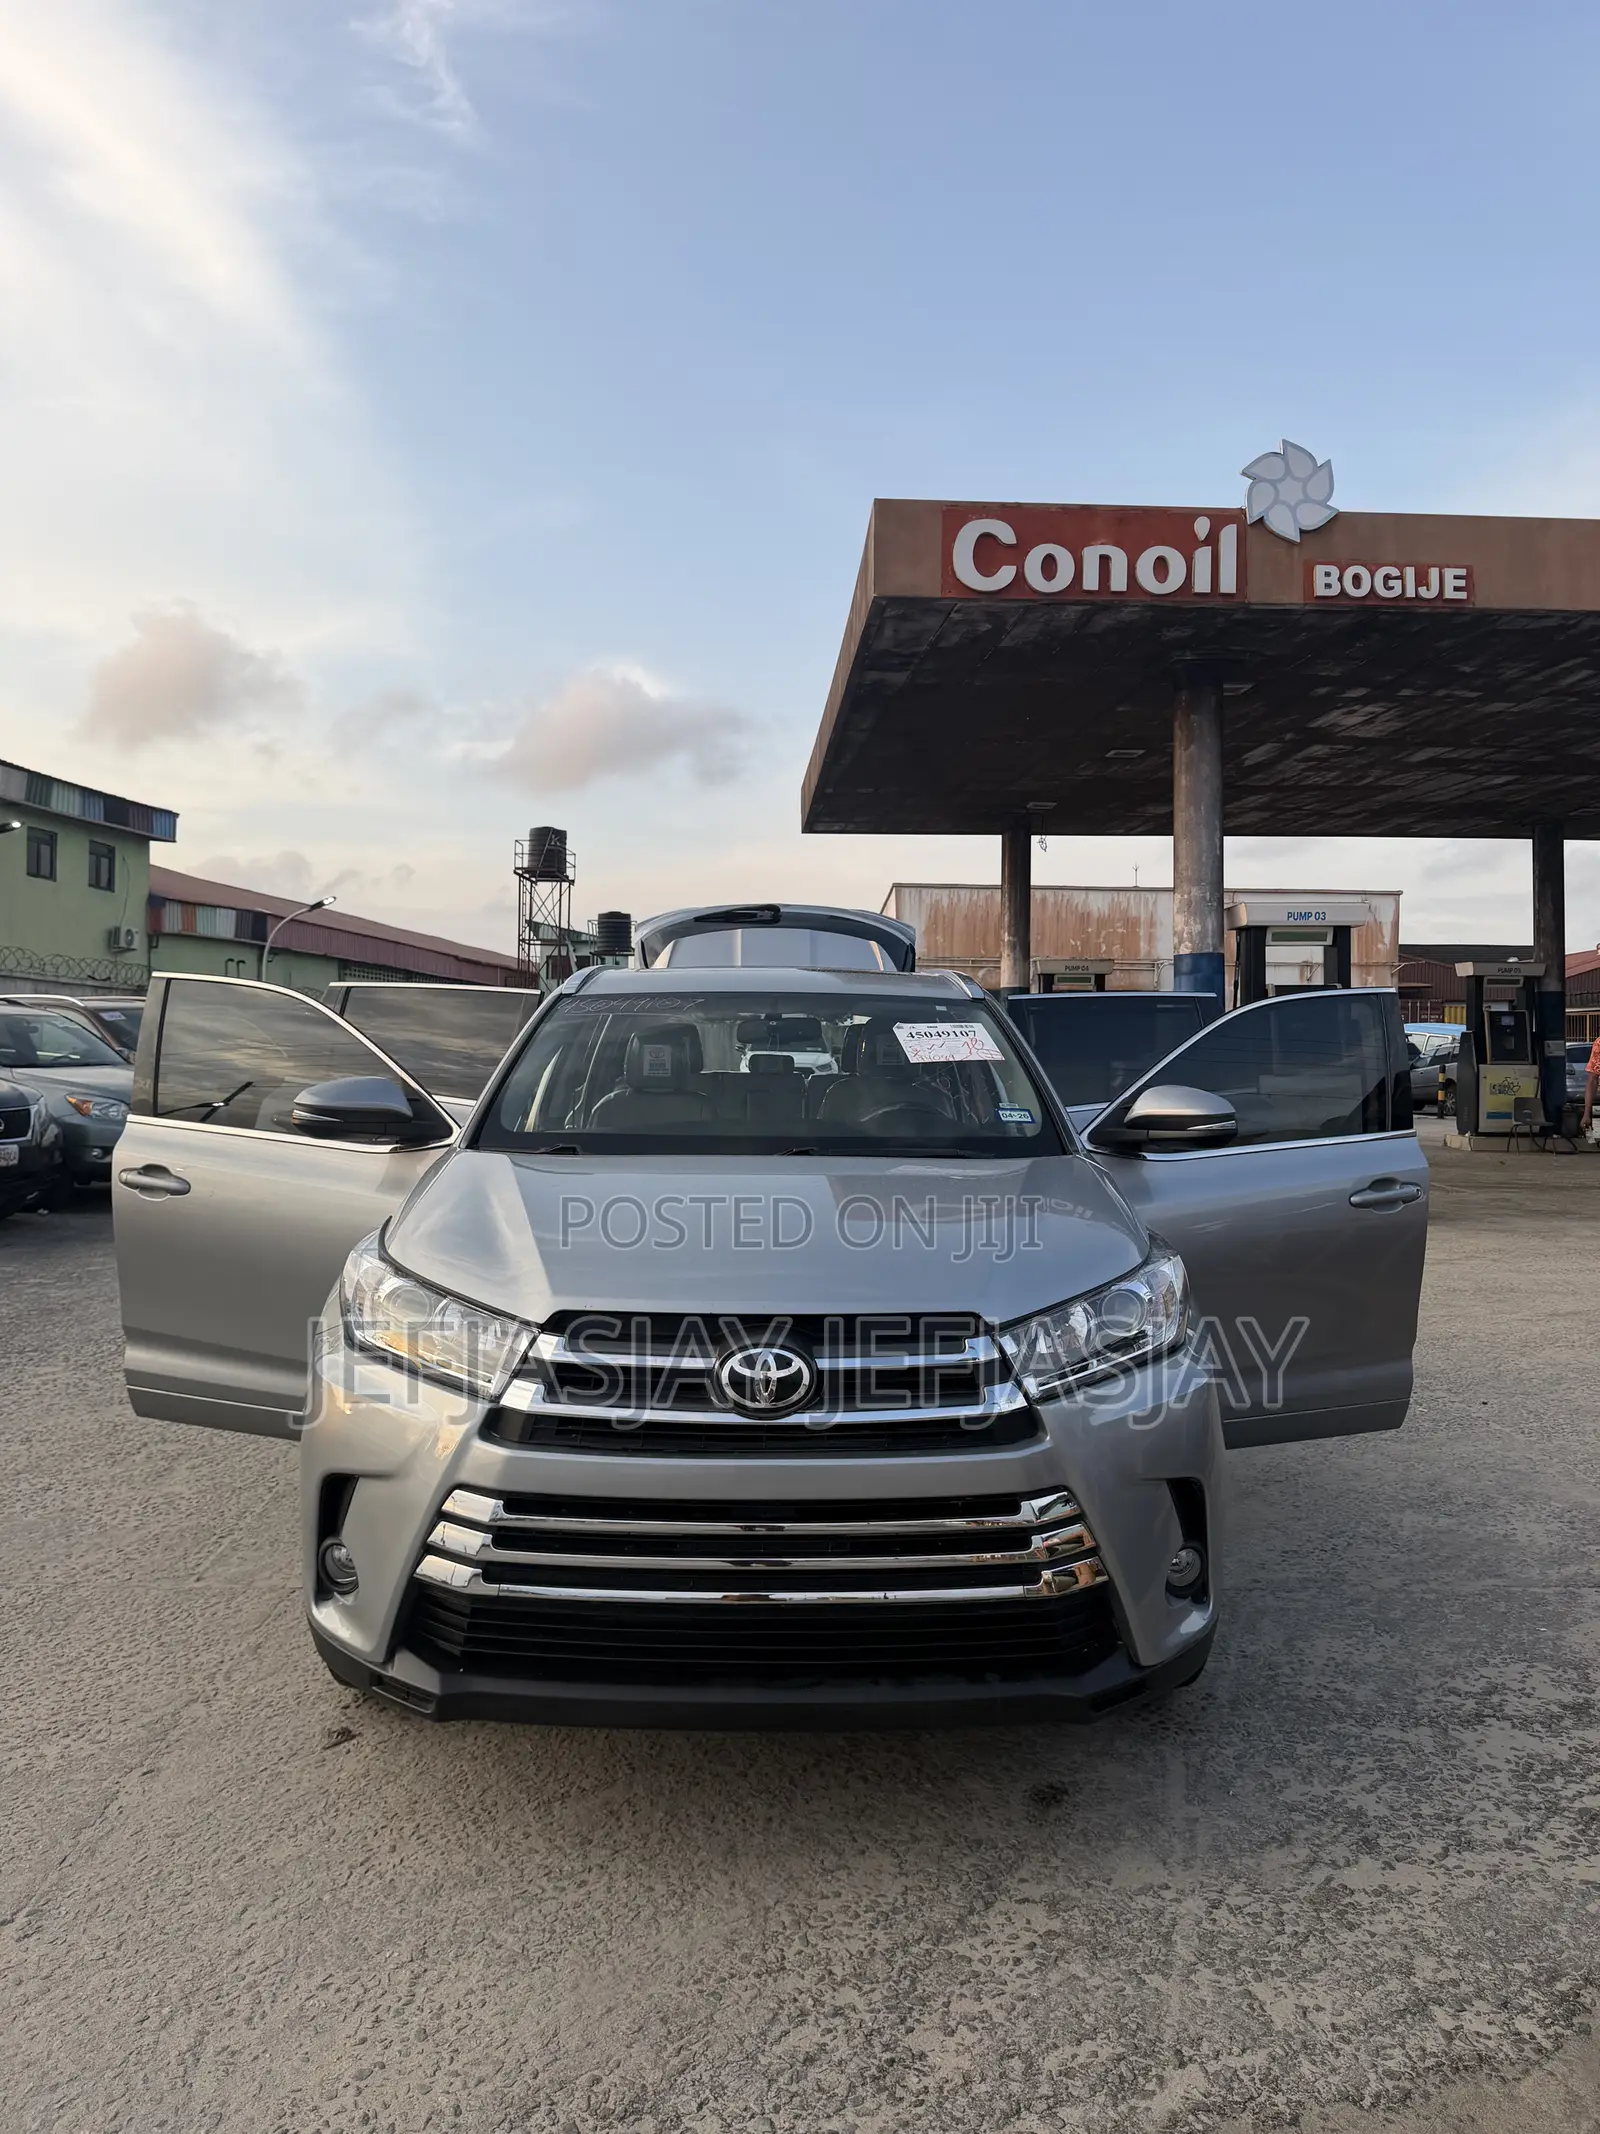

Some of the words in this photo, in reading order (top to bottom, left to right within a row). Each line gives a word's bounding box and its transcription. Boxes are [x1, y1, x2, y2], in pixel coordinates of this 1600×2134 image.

[952, 515, 1238, 595] Conoil
[1312, 564, 1469, 600] BOGIJE
[1287, 911, 1313, 921] PUMP
[1314, 911, 1327, 921] 03
[906, 1030, 977, 1039] 45049107
